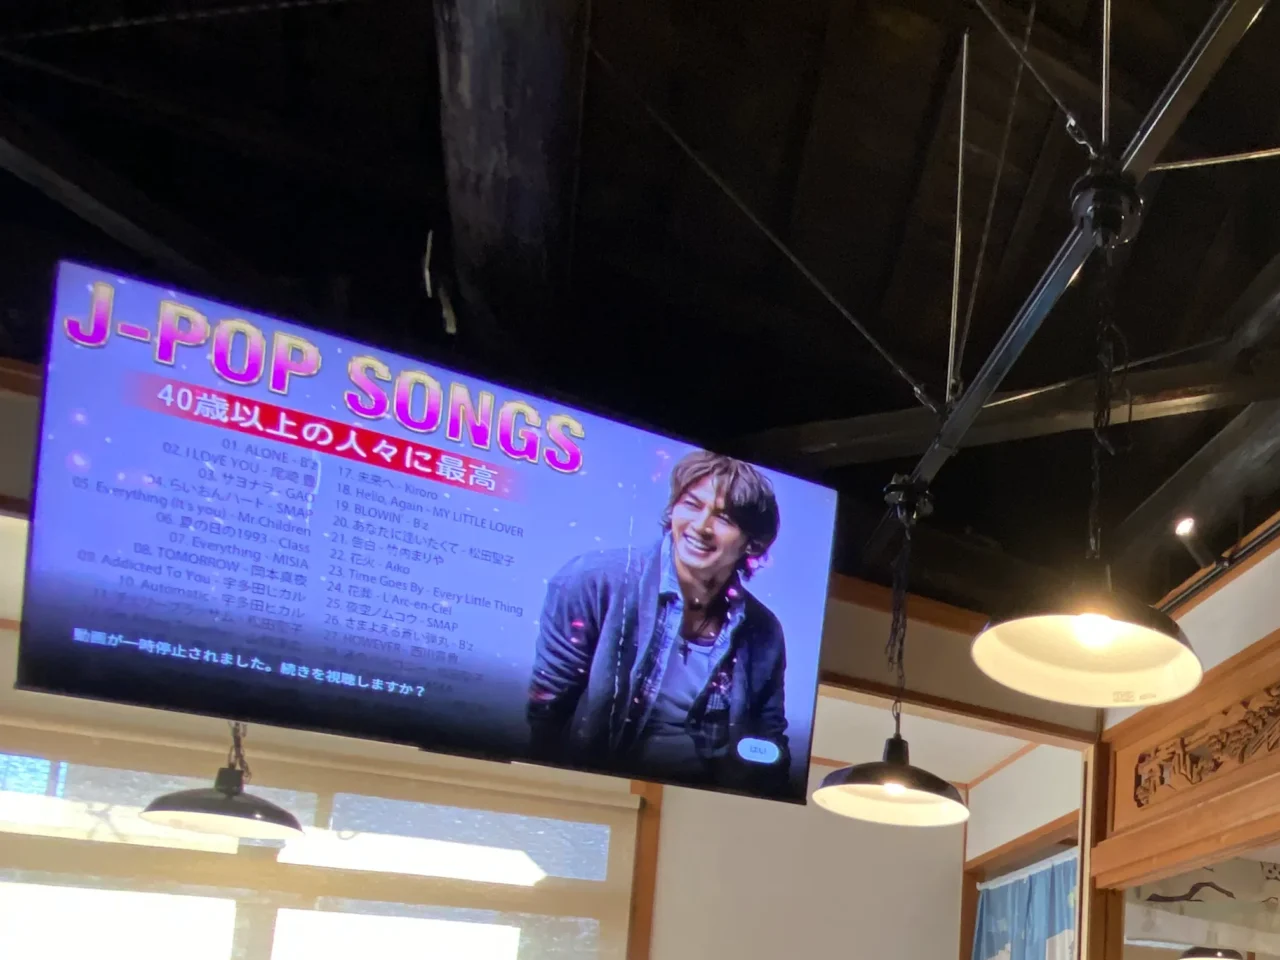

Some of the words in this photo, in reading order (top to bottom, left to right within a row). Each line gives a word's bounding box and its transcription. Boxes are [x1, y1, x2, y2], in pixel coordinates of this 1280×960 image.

[63, 279, 322, 395] J-POP
[343, 353, 586, 473] SONGS
[154, 379, 498, 492] 40歳以上の人々に最高
[192, 448, 227, 466] LOVE
[229, 456, 259, 474] YOU
[244, 442, 288, 463] ALONE
[221, 471, 274, 495] サヨナラ
[404, 481, 438, 500] Kiroro
[275, 501, 313, 521] SMAP
[390, 495, 423, 516] Again
[432, 505, 450, 520] MY
[488, 519, 524, 538] LOVER
[191, 535, 261, 563] Everything
[272, 552, 309, 569] MISIA
[278, 536, 310, 554] Class
[100, 552, 162, 575] Addicted
[166, 565, 182, 579] To
[185, 569, 210, 584] You
[157, 545, 239, 573] TOMORROW
[385, 559, 410, 575] Aiko
[140, 578, 209, 602] Automatic
[348, 567, 377, 584] Time
[379, 574, 408, 590] Goes
[409, 581, 424, 596] By
[431, 586, 463, 605] Every
[464, 592, 491, 608] Little
[493, 598, 523, 618] Thing
[426, 616, 458, 633] SMAP
[458, 639, 473, 651] B'z
